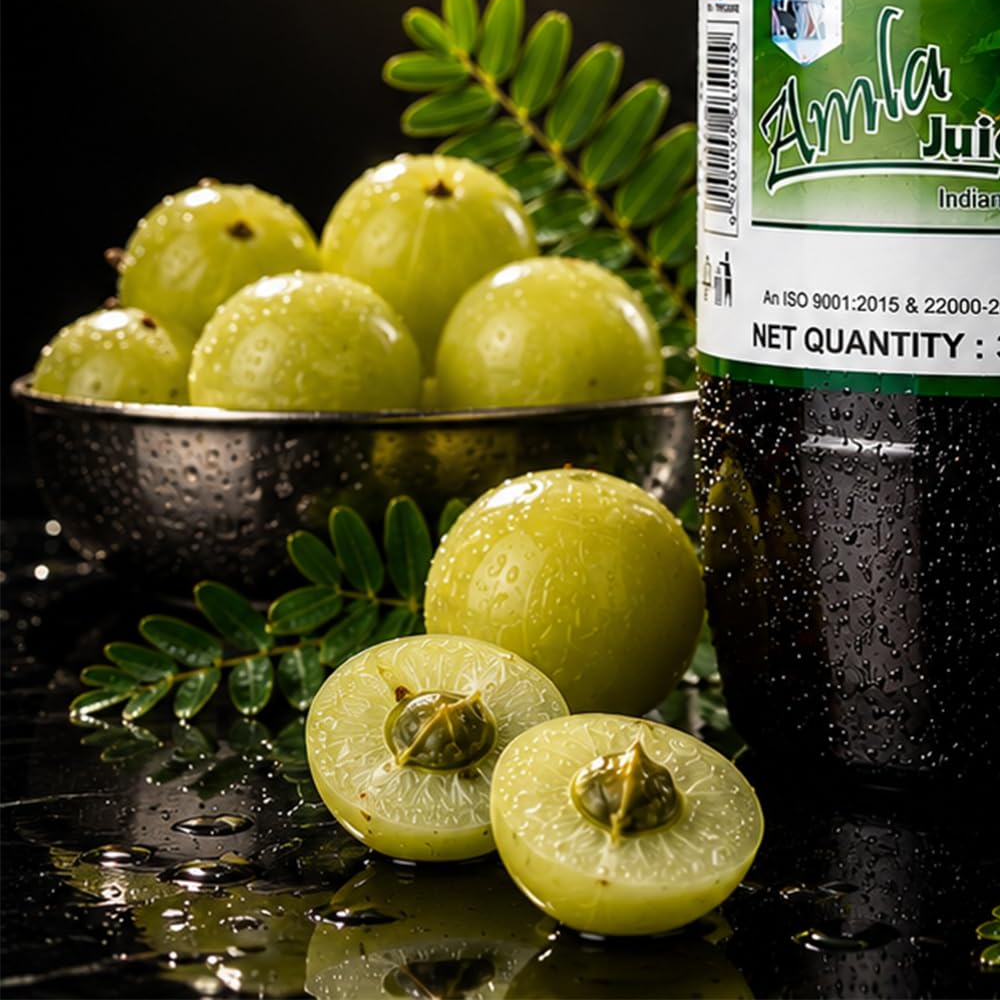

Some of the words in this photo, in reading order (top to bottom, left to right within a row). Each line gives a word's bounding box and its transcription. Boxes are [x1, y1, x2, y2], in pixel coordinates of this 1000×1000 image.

[759, 6, 952, 194] Amla
[763, 290, 780, 306] An
[783, 291, 808, 308] ISO
[812, 294, 901, 312] 9001:2015
[905, 298, 919, 314] &
[752, 323, 798, 351] NET
[804, 327, 965, 359] QUANTITY
